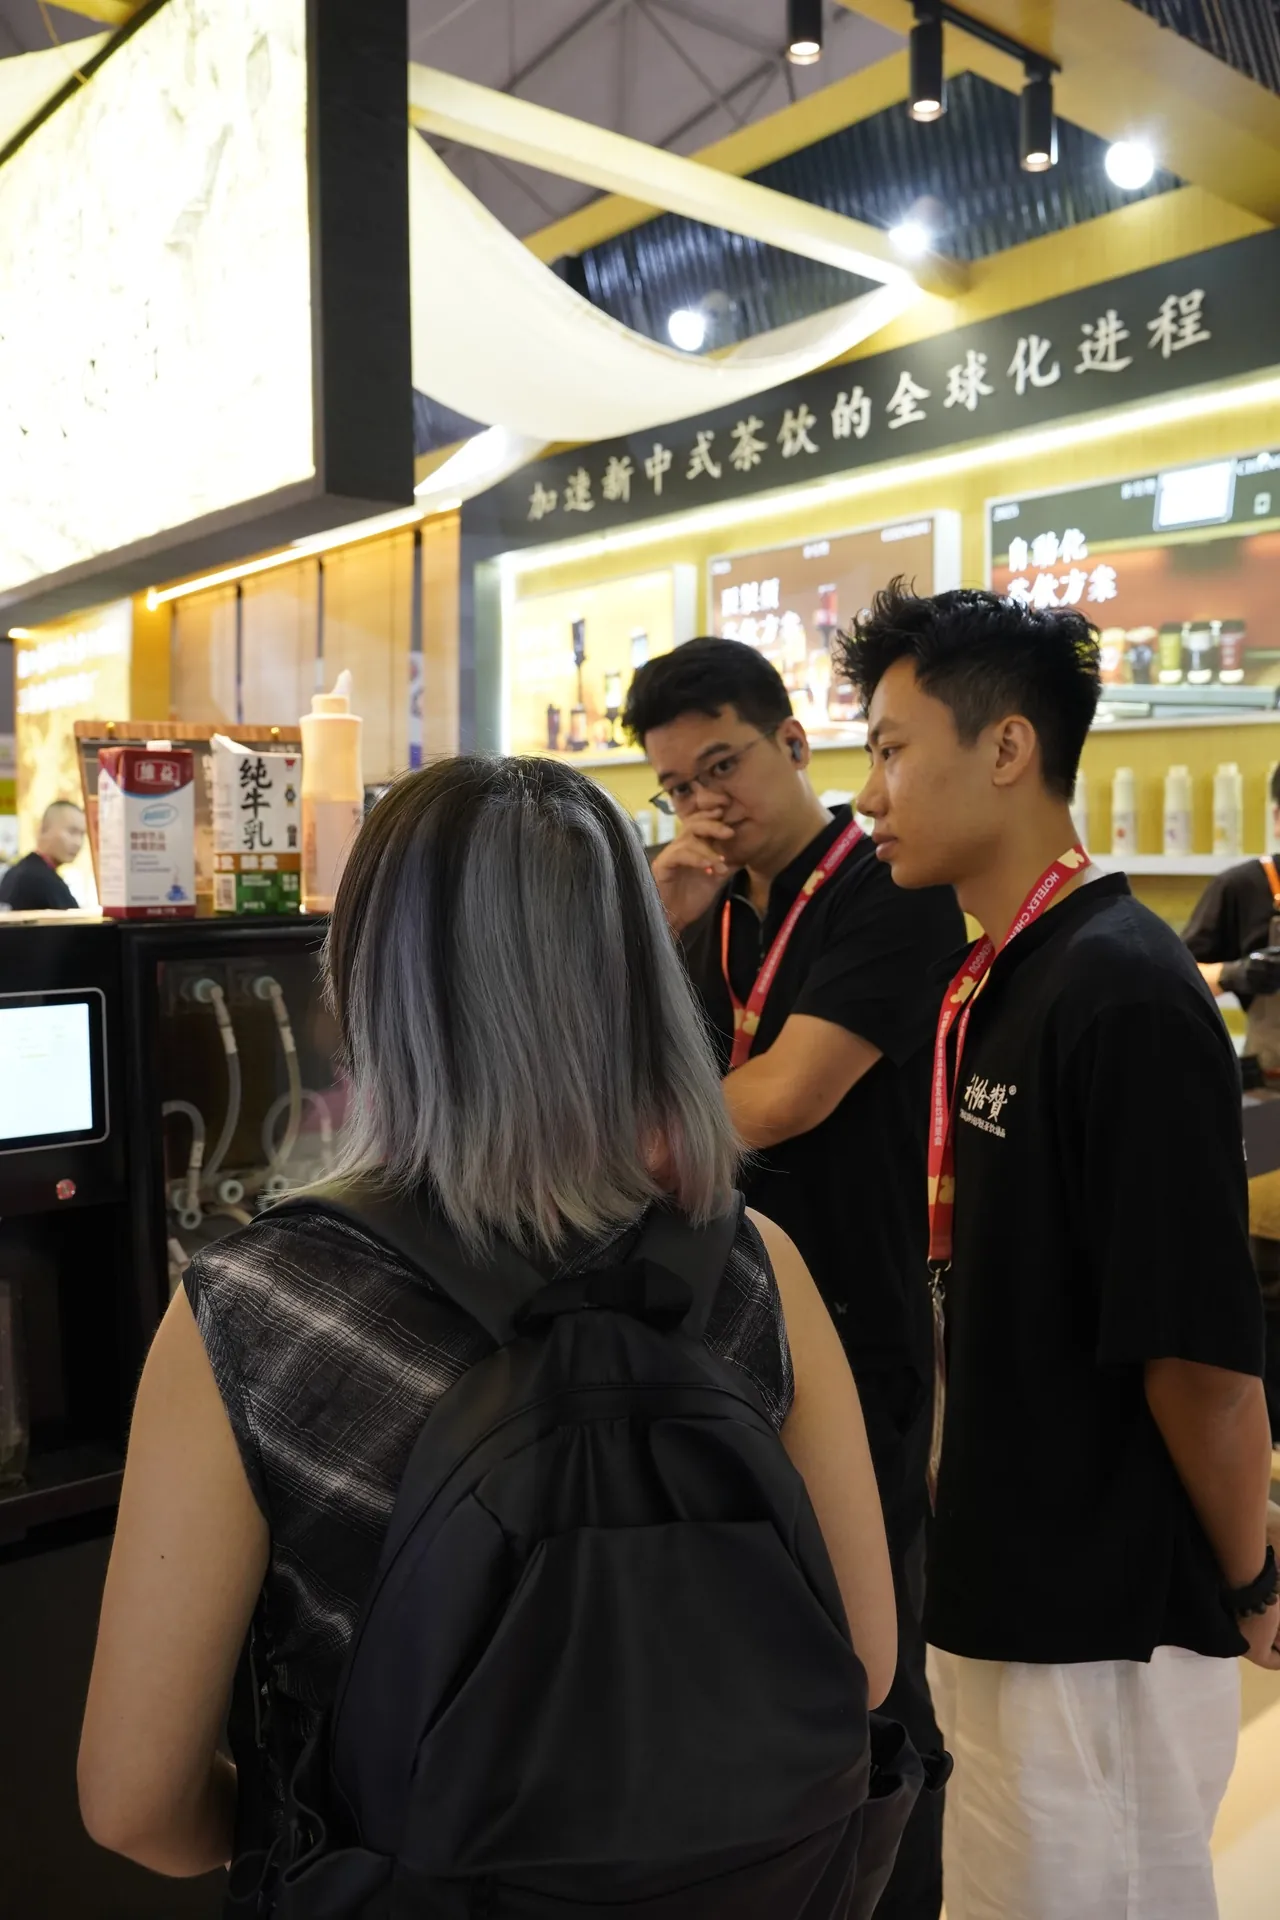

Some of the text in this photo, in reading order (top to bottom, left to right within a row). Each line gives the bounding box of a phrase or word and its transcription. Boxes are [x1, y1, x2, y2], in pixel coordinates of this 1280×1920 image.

[527, 288, 1212, 521] 加速新中式茶饮的全球化进程
[239, 757, 273, 850] 纯牛乳
[1027, 871, 1060, 913] HOTELEX
